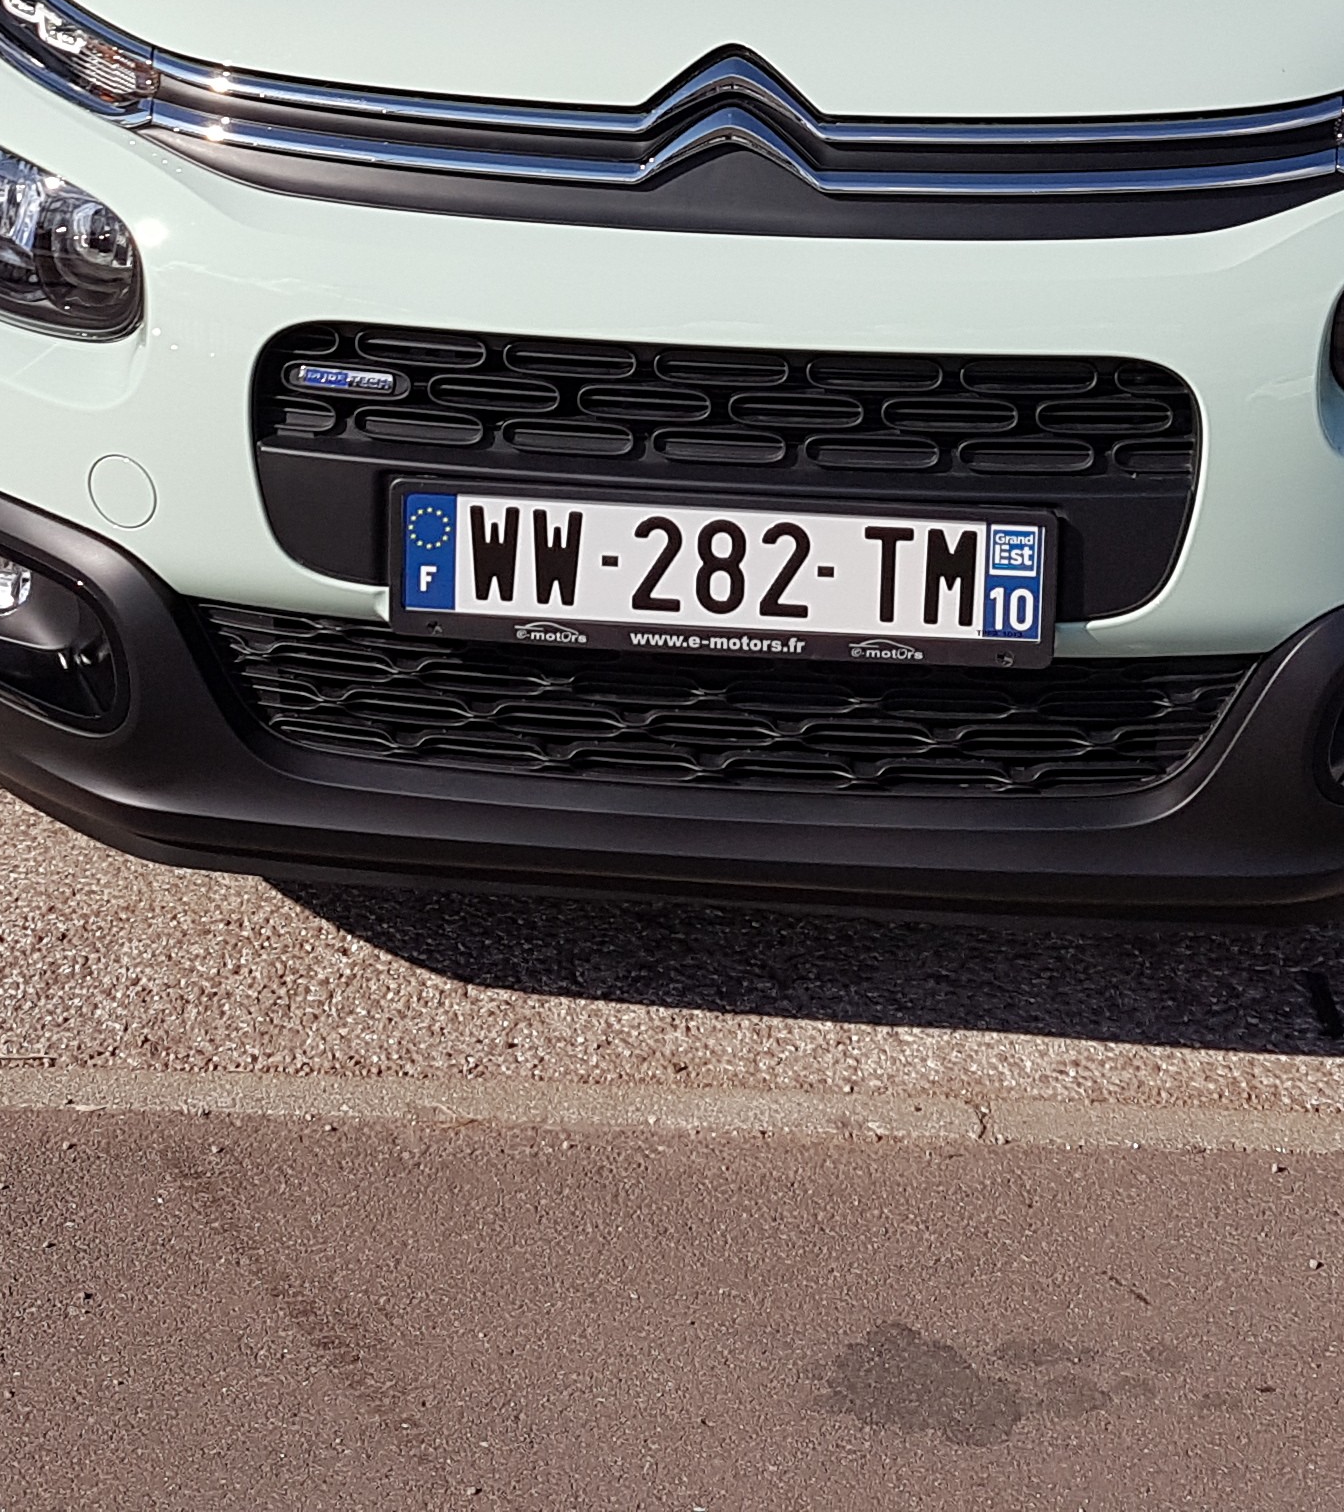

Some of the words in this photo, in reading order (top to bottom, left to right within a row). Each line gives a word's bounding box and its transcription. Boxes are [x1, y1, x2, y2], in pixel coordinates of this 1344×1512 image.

[995, 533, 1034, 545] Grand
[469, 505, 978, 627] WW-282-TM
[994, 544, 1033, 566] Est
[420, 566, 437, 592] F
[989, 586, 1034, 631] 10
[630, 632, 805, 653] www.e-motors.fr
